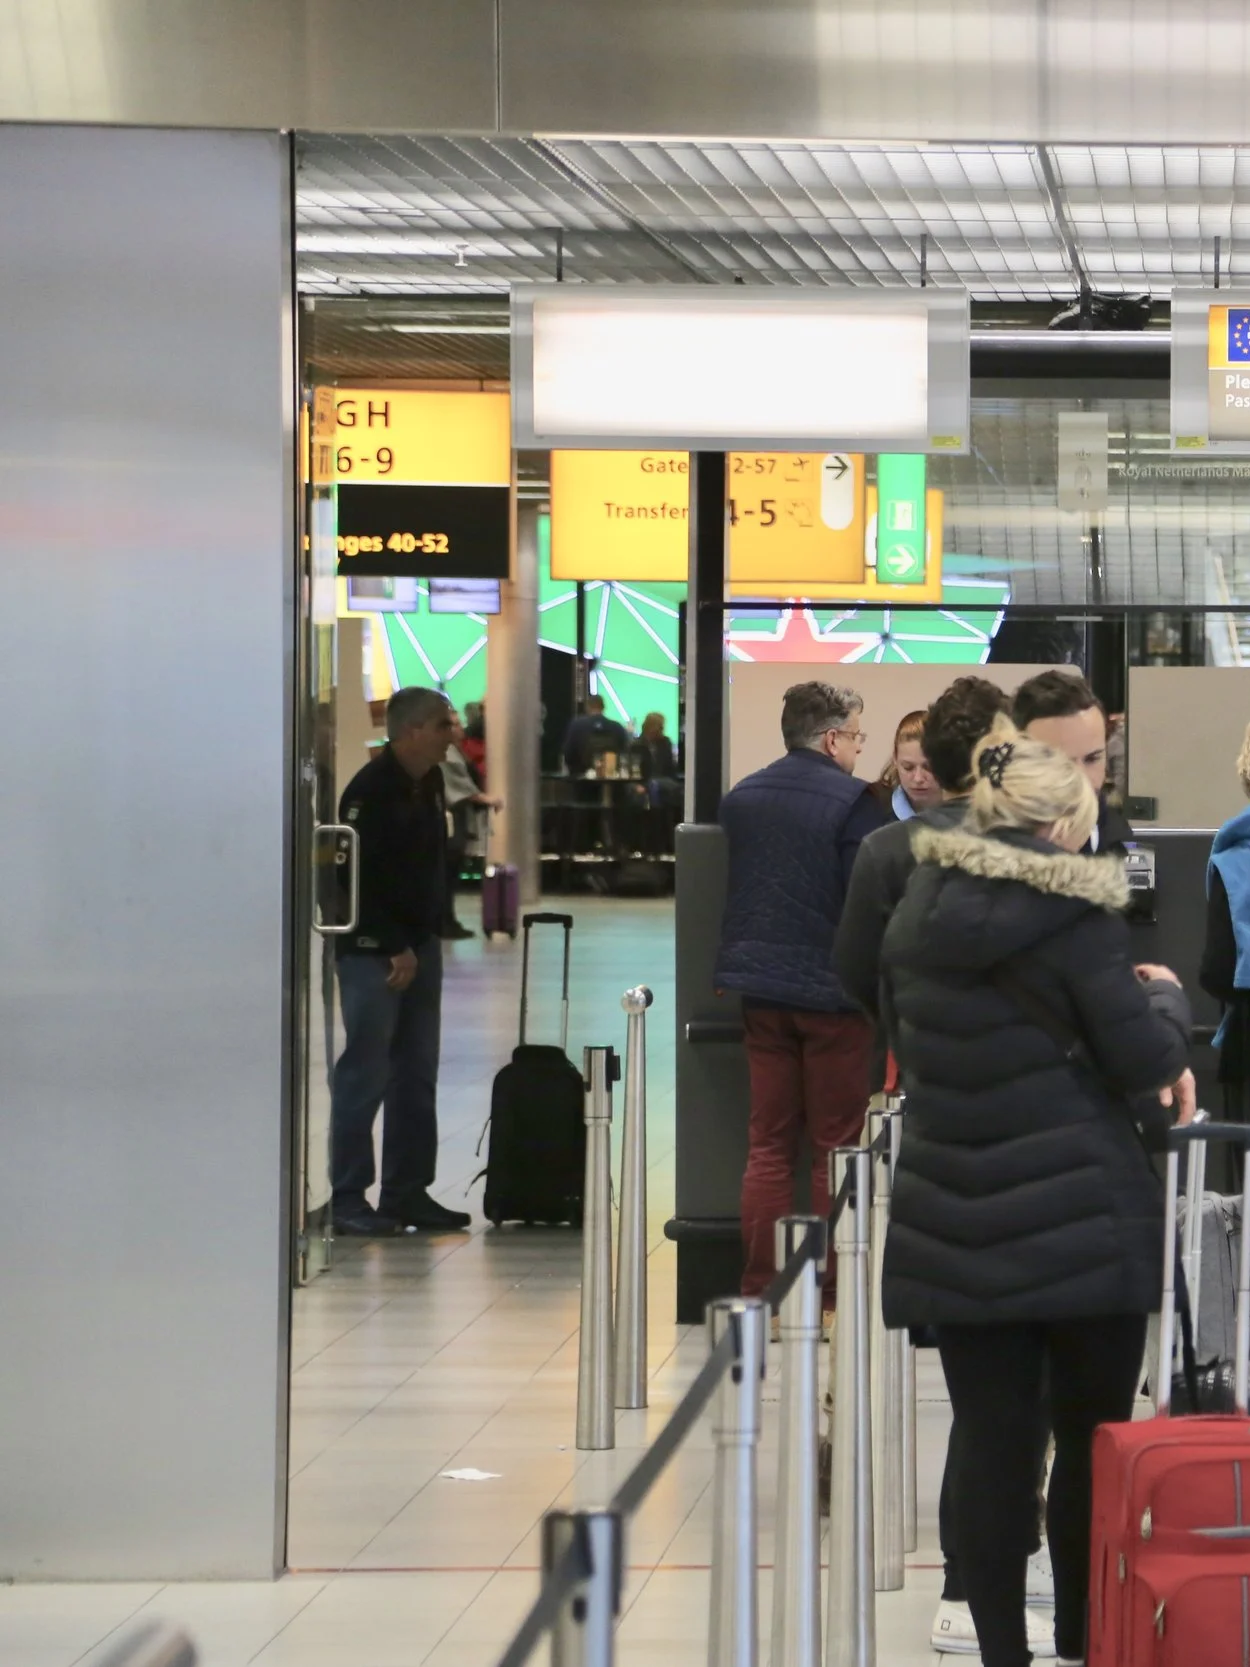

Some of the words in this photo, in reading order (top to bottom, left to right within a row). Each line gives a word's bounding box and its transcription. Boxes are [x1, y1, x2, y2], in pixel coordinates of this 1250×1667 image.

[641, 457, 688, 474] Gate
[1119, 465, 1151, 480] Royal
[1155, 465, 1229, 477] Netherlands
[387, 532, 449, 554] 40-52
